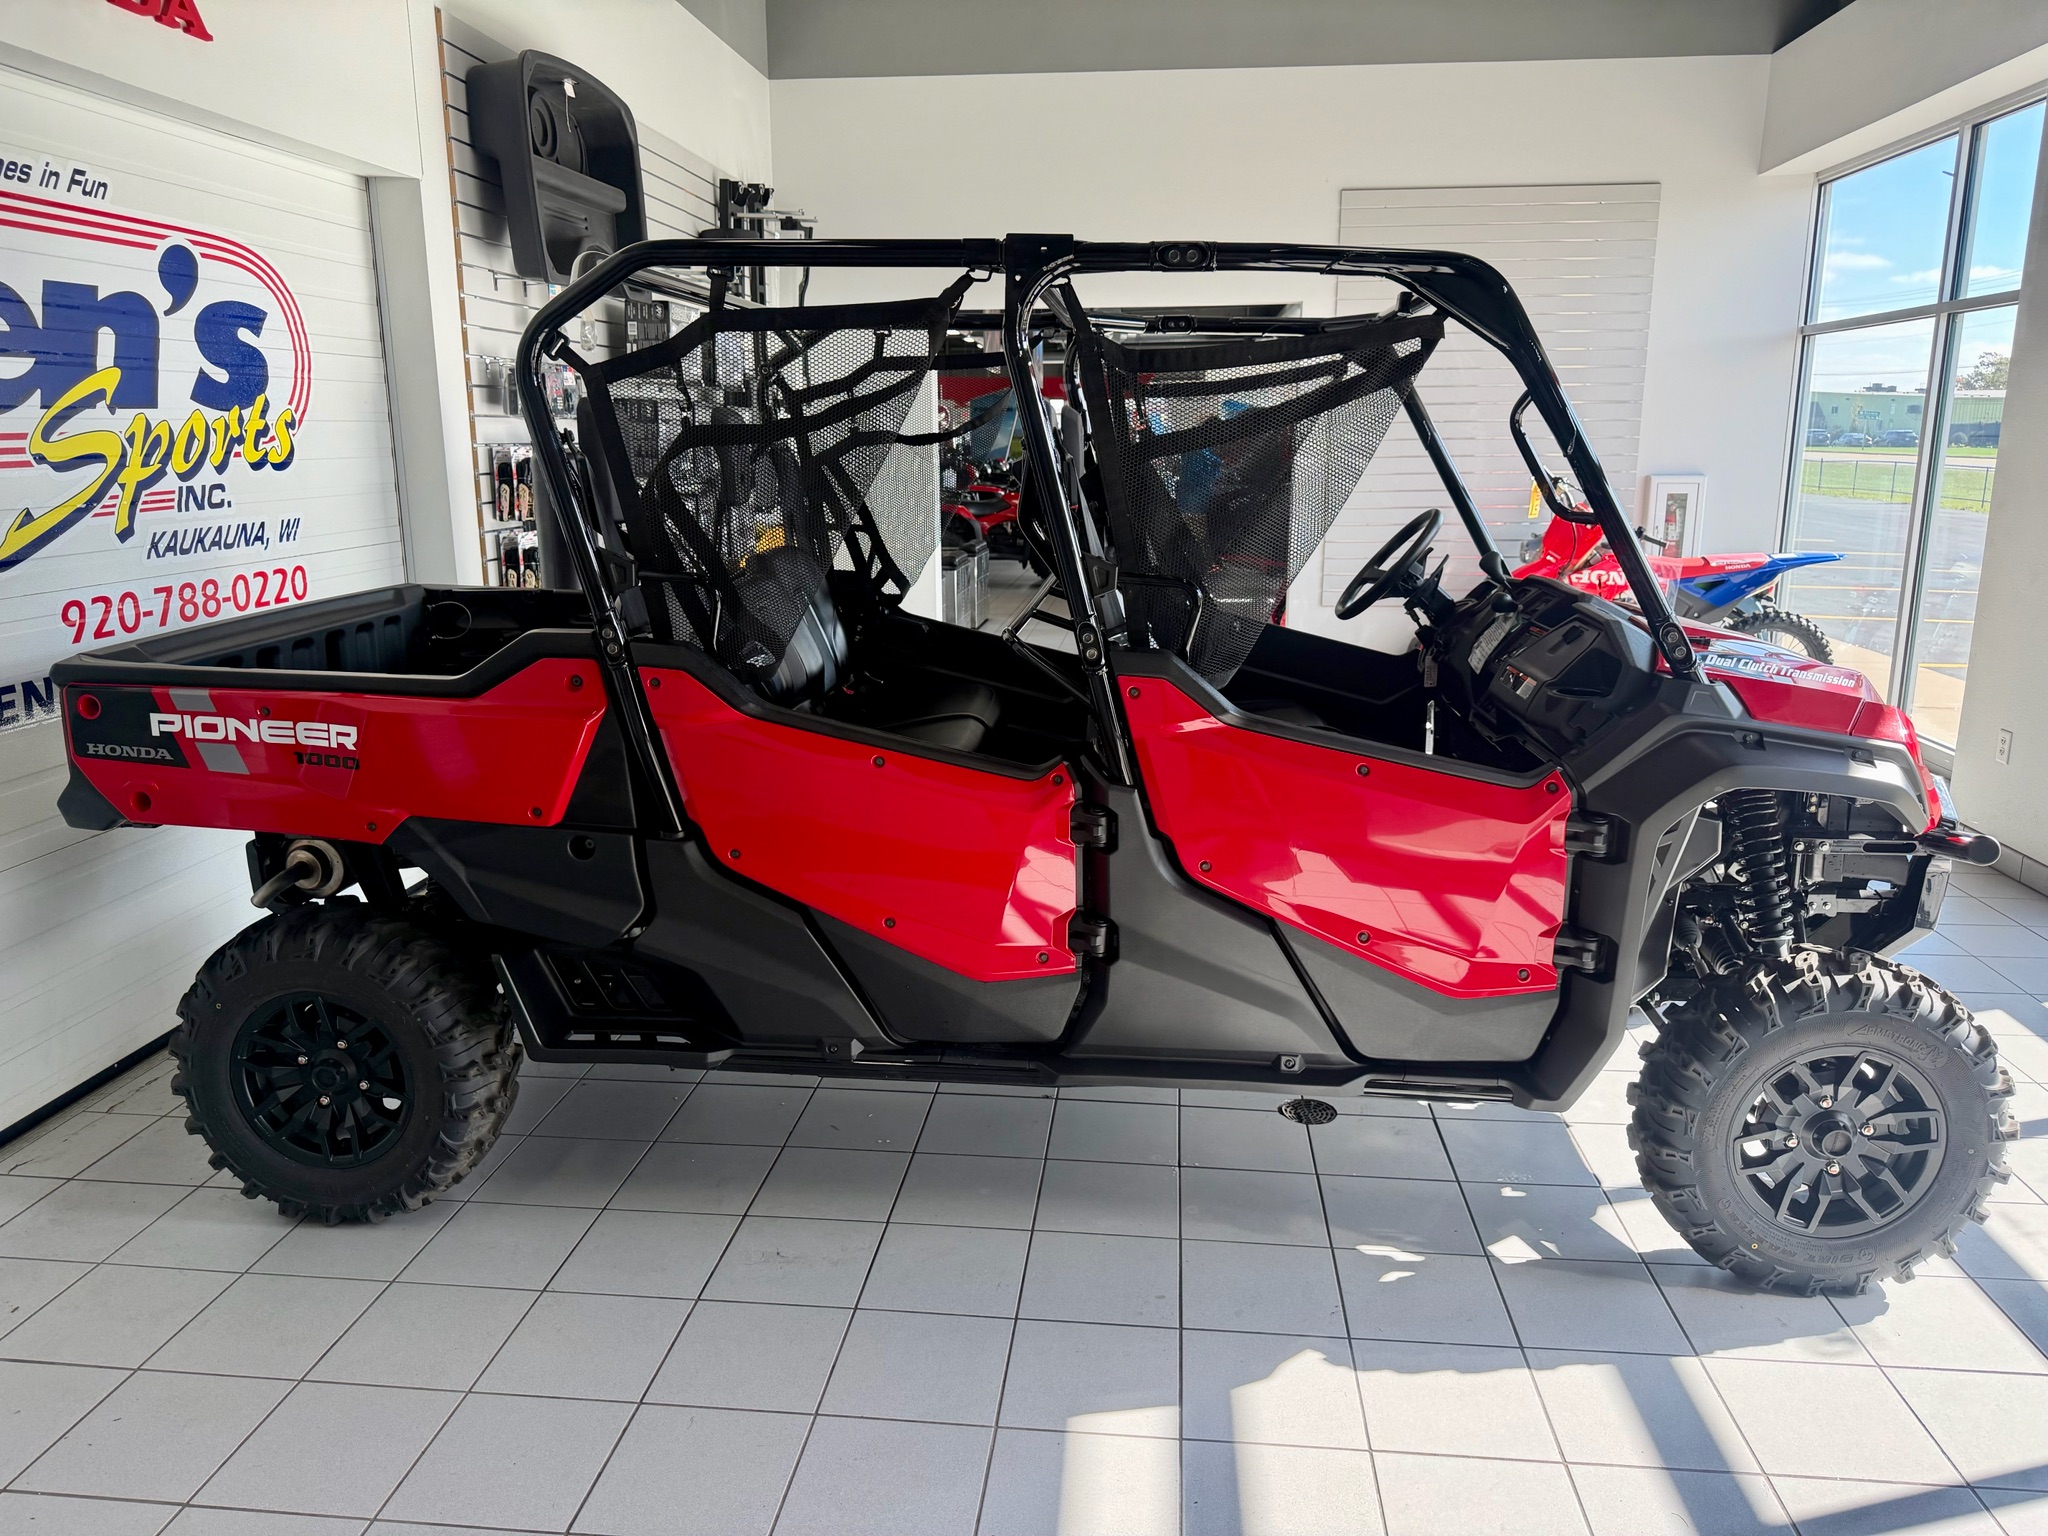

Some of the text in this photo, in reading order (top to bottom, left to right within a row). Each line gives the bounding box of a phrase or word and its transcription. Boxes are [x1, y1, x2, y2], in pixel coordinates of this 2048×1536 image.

[0, 159, 108, 200] es in Fun
[0, 366, 296, 573] Sports
[176, 483, 232, 512] INC.
[146, 518, 301, 559] KAUKAUNA, WI
[1570, 569, 1626, 587] HON
[1724, 563, 1752, 571] HONDA
[61, 565, 308, 645] 920-788-0220
[1705, 654, 1856, 688] Dual Clutch Transmission
[149, 712, 357, 750] PIONEER
[86, 743, 174, 761] HONDA
[293, 751, 360, 770] 1000
